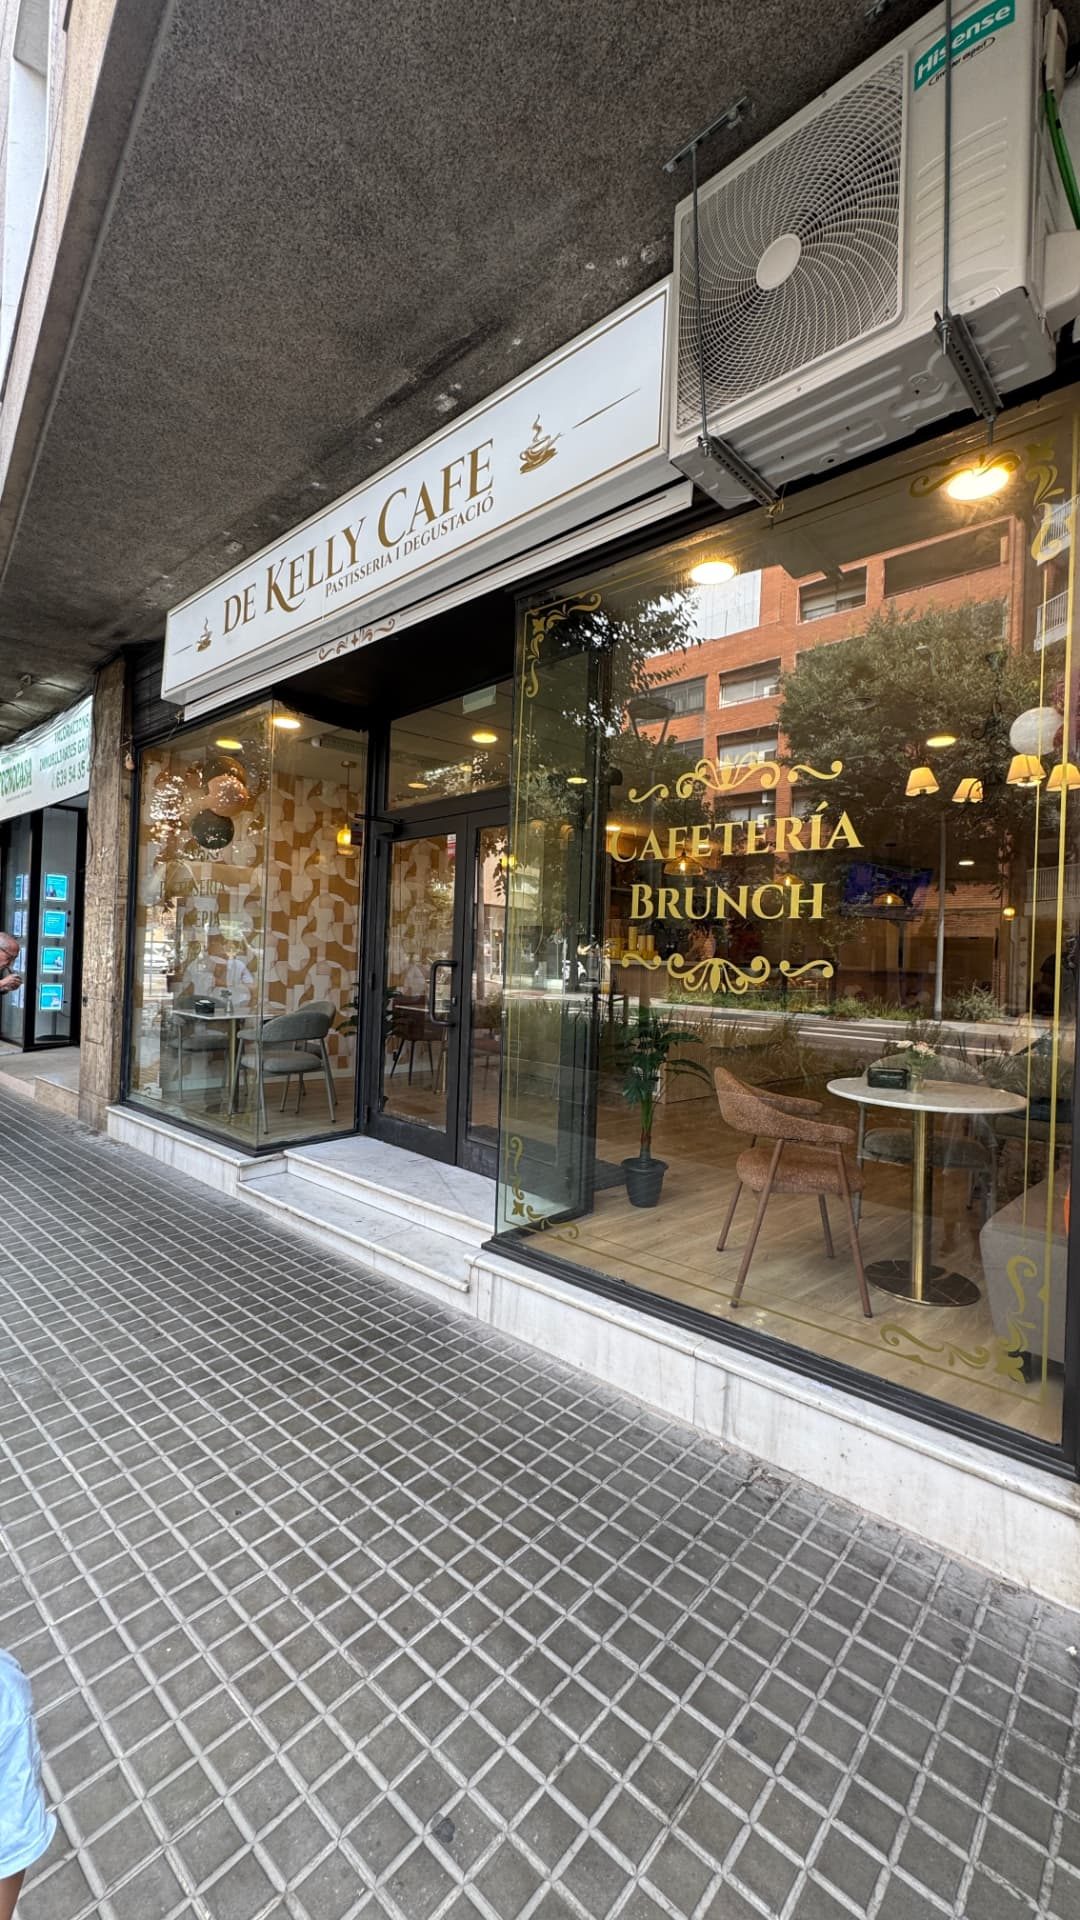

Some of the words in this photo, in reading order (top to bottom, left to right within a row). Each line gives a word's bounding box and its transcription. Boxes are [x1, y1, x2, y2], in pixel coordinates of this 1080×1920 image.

[917, 5, 1011, 81] Hisense
[223, 582, 257, 636] DE
[264, 515, 367, 613] KELLY
[377, 437, 494, 548] CAFE
[325, 551, 393, 598] PASTISSERIA
[403, 491, 494, 556] DEGUSTACIÓ
[609, 801, 864, 863] CAFETERÍA
[630, 883, 826, 919] BRUNCH
